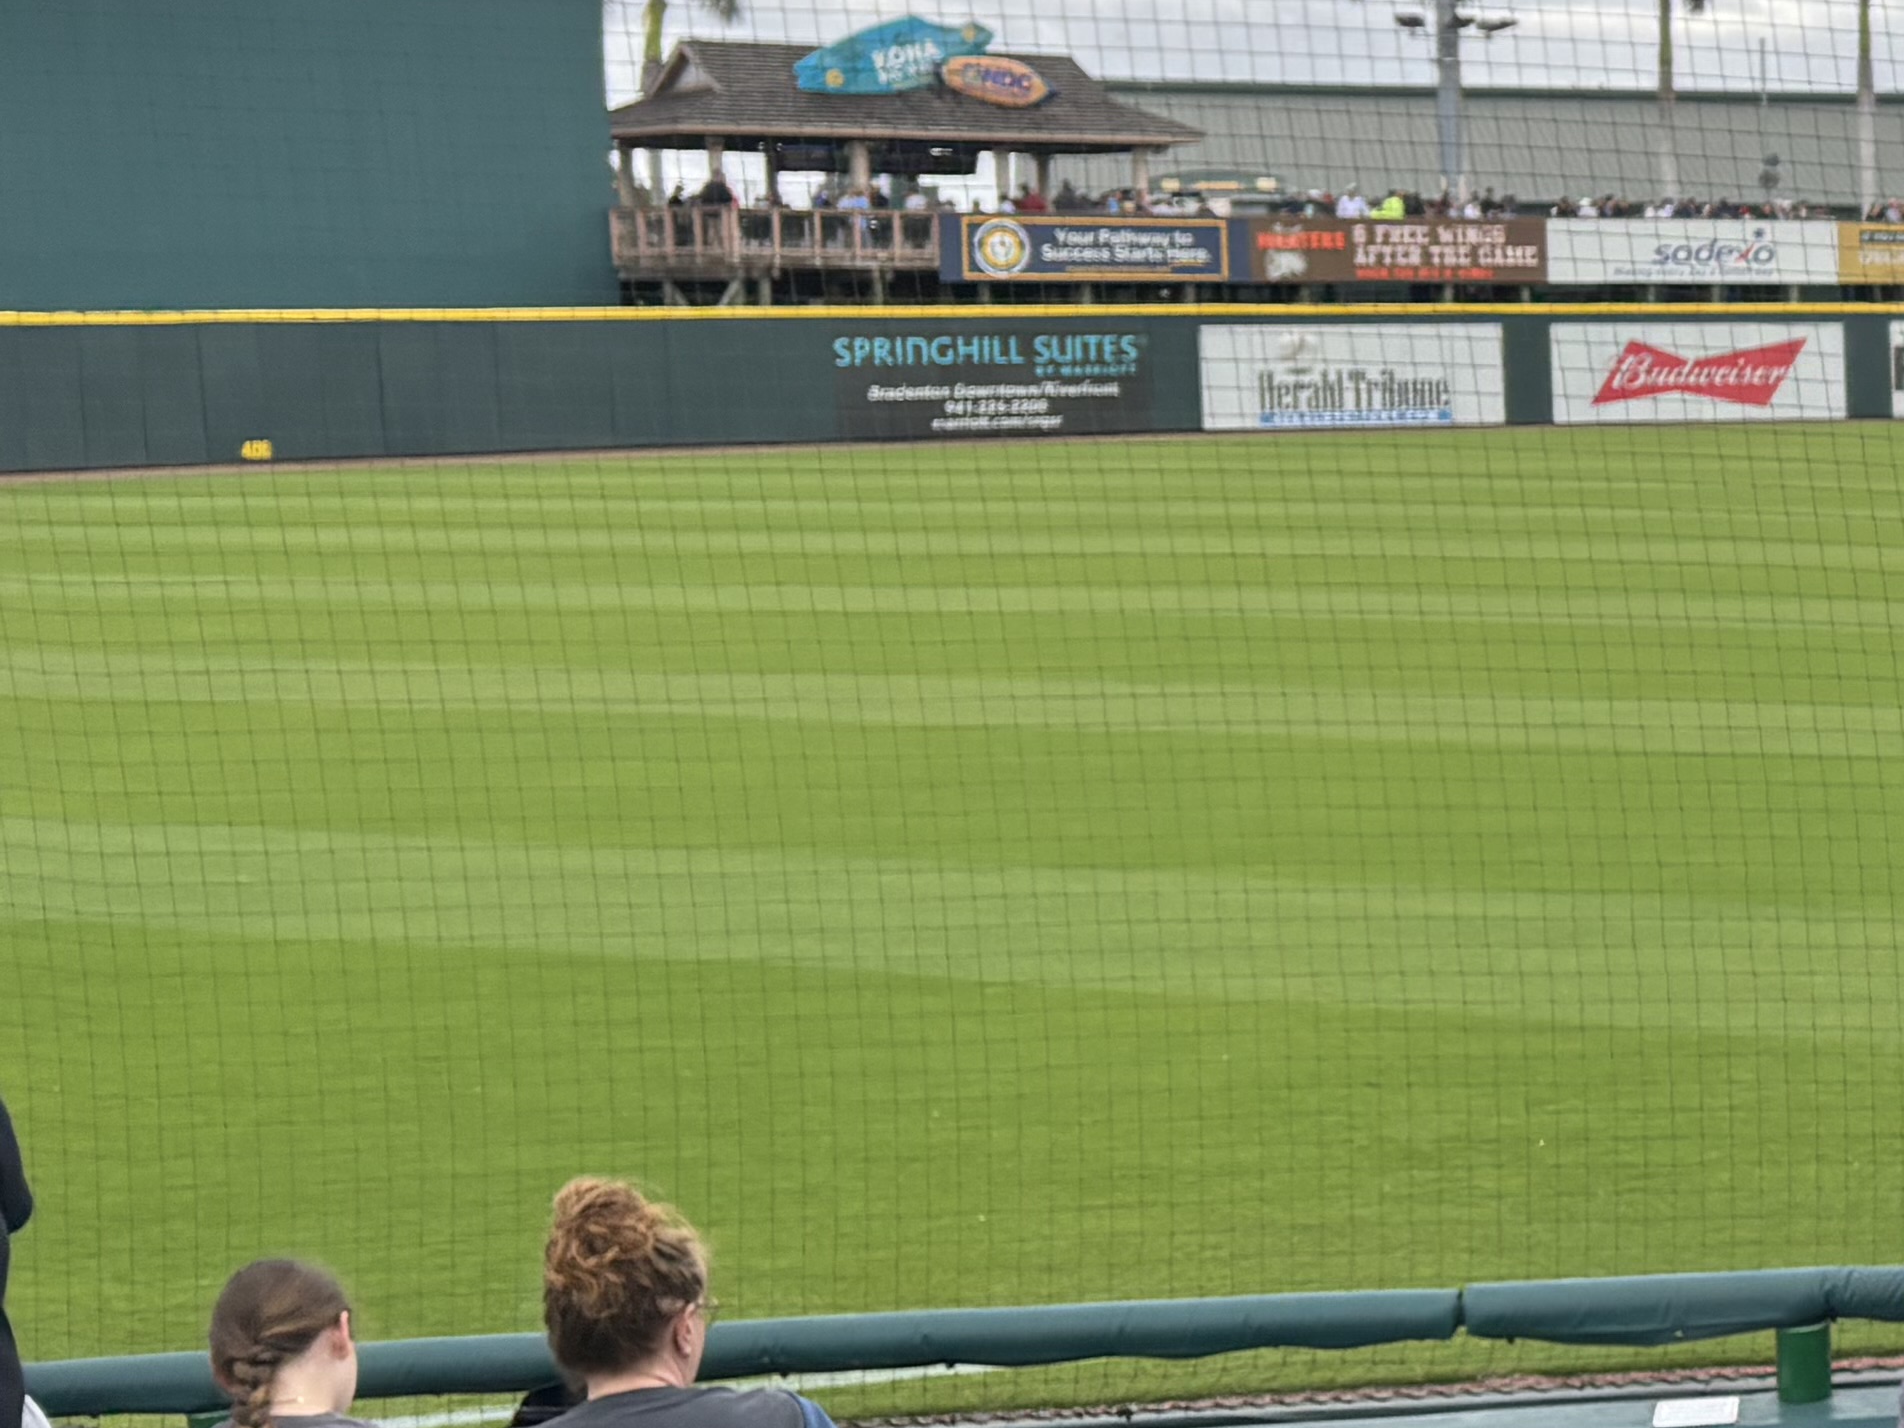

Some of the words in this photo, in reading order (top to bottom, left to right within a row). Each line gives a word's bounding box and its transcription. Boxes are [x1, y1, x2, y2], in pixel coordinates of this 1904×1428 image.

[1375, 224, 1429, 244] FREE
[1436, 224, 1506, 244] WINGS
[1354, 245, 1422, 266] AFTER
[1429, 245, 1472, 266] THE
[1478, 245, 1538, 267] GAME
[1652, 235, 1774, 266] sodexo
[833, 335, 1025, 367] SPRINGHILL
[1032, 334, 1138, 364] SUITES
[1610, 352, 1793, 390] Budweiser
[867, 383, 951, 402] Bradenton
